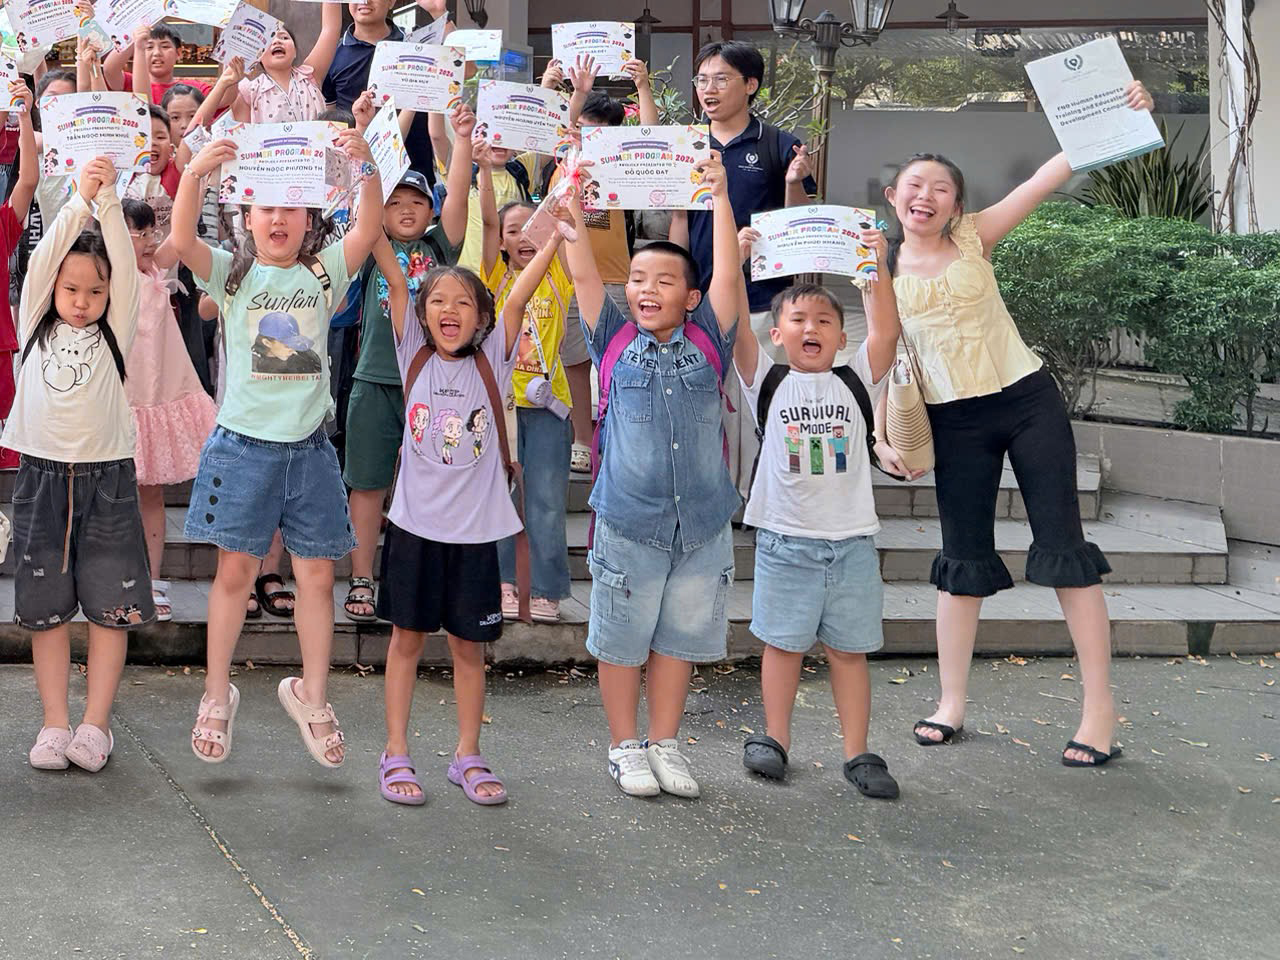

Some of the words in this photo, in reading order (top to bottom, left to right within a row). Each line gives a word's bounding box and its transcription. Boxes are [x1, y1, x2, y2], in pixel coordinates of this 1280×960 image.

[438, 68, 454, 78] 2026
[1070, 96, 1094, 107] Human
[1093, 86, 1124, 100] Resource
[1055, 108, 1082, 120] Training
[1082, 103, 1094, 112] and
[1060, 109, 1102, 127] Development
[122, 119, 139, 129] 2026
[240, 149, 272, 161] SUMMER
[274, 148, 312, 157] PROGRAM
[600, 152, 632, 165] SUMMER
[634, 152, 673, 160] PROGRAM
[675, 154, 695, 164] 2026
[239, 163, 265, 172] NGUYỄN
[841, 229, 861, 240] 2026
[246, 288, 320, 313] Surfari
[780, 405, 851, 424] SURVIVAL
[800, 422, 832, 435] MODE
